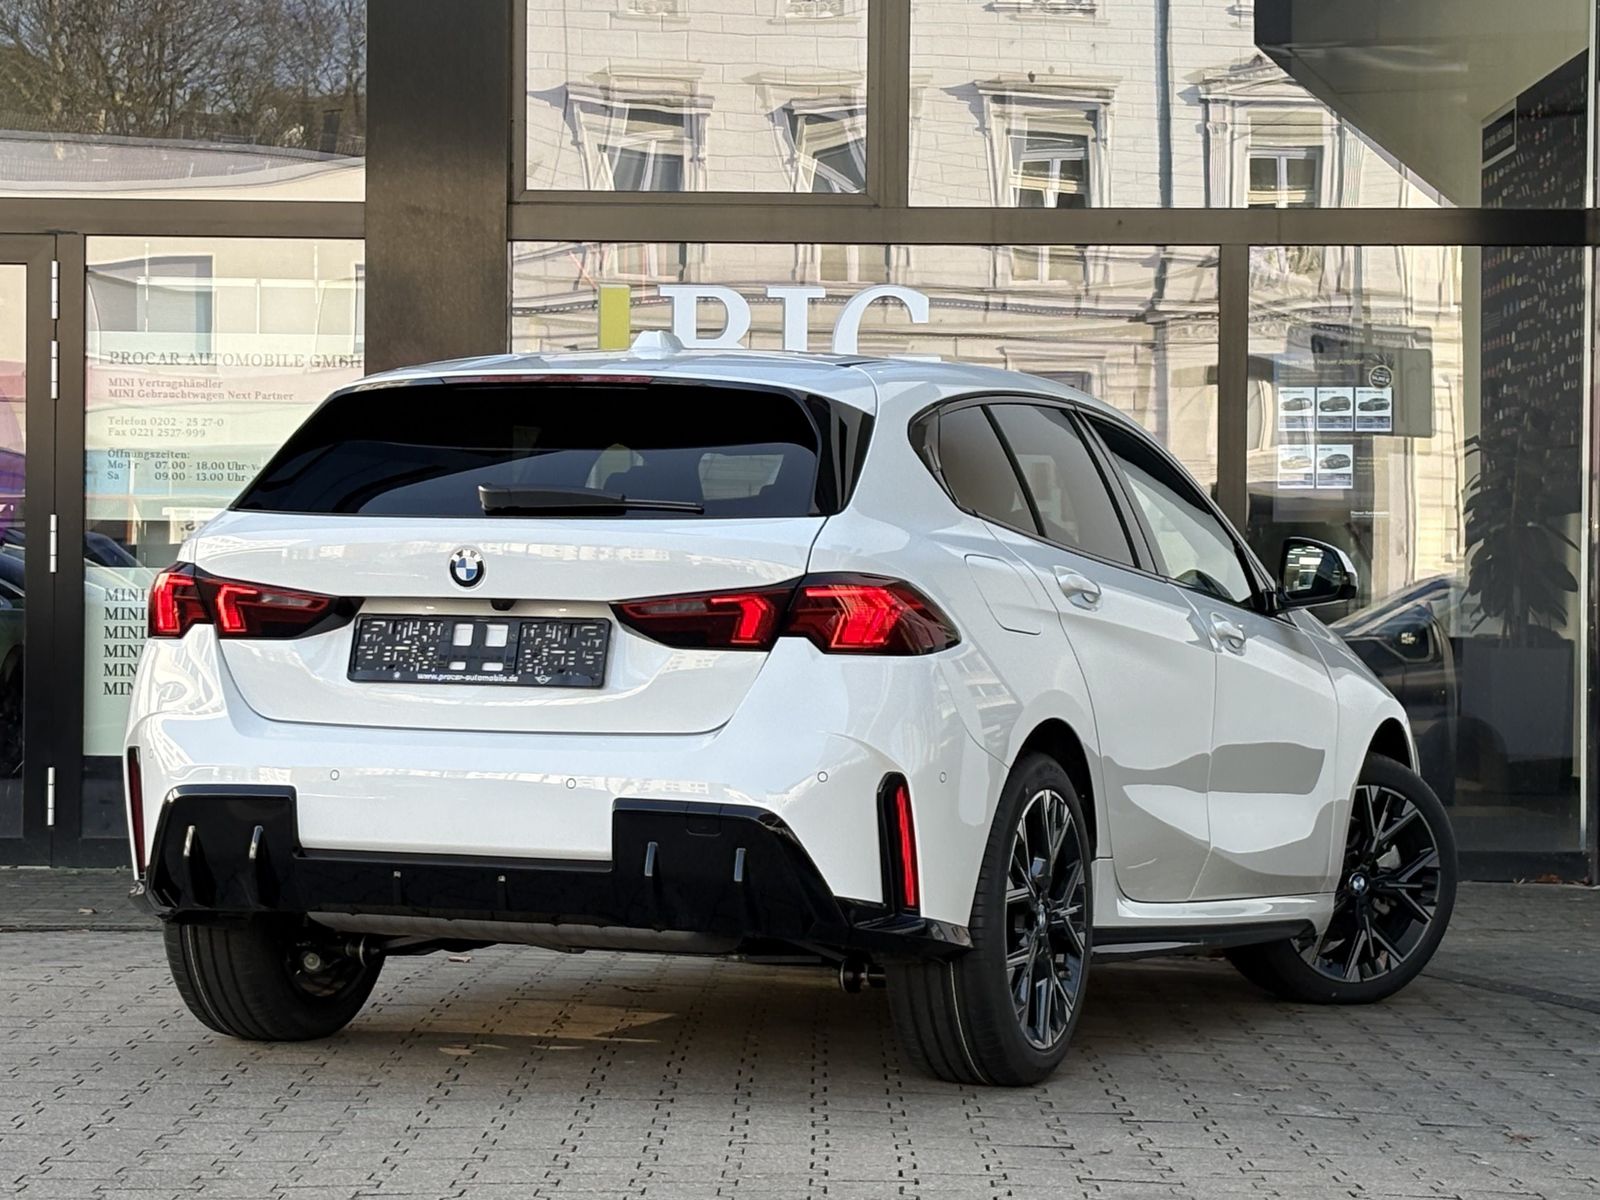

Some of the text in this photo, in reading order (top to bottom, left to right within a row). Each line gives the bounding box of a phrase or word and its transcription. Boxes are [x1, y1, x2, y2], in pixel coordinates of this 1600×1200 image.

[109, 350, 180, 366] PROCAR
[187, 352, 305, 368] AUTOMOBILE
[108, 378, 224, 390] MINI Vertragshändler
[108, 389, 295, 401] MINI Gebrauchtwagen Next Partner
[107, 416, 147, 426] Telefon
[149, 417, 177, 426] 0202
[186, 418, 199, 427] 25
[201, 418, 225, 427] 27-0
[107, 428, 206, 438] Fax 0221 2527-999
[107, 449, 190, 461] Öffnungszeiten:
[154, 461, 186, 470] 07.00
[196, 462, 225, 471] 18.00
[227, 461, 247, 471] Uhr
[107, 471, 120, 481] Sa
[154, 472, 186, 481] 09.00
[196, 472, 225, 482] 13.00
[227, 472, 247, 482] Uhr
[104, 588, 146, 601] MINI
[104, 607, 146, 620] MINI
[104, 626, 146, 639] MINI
[417, 673, 519, 682] www.procar-automobile.de
